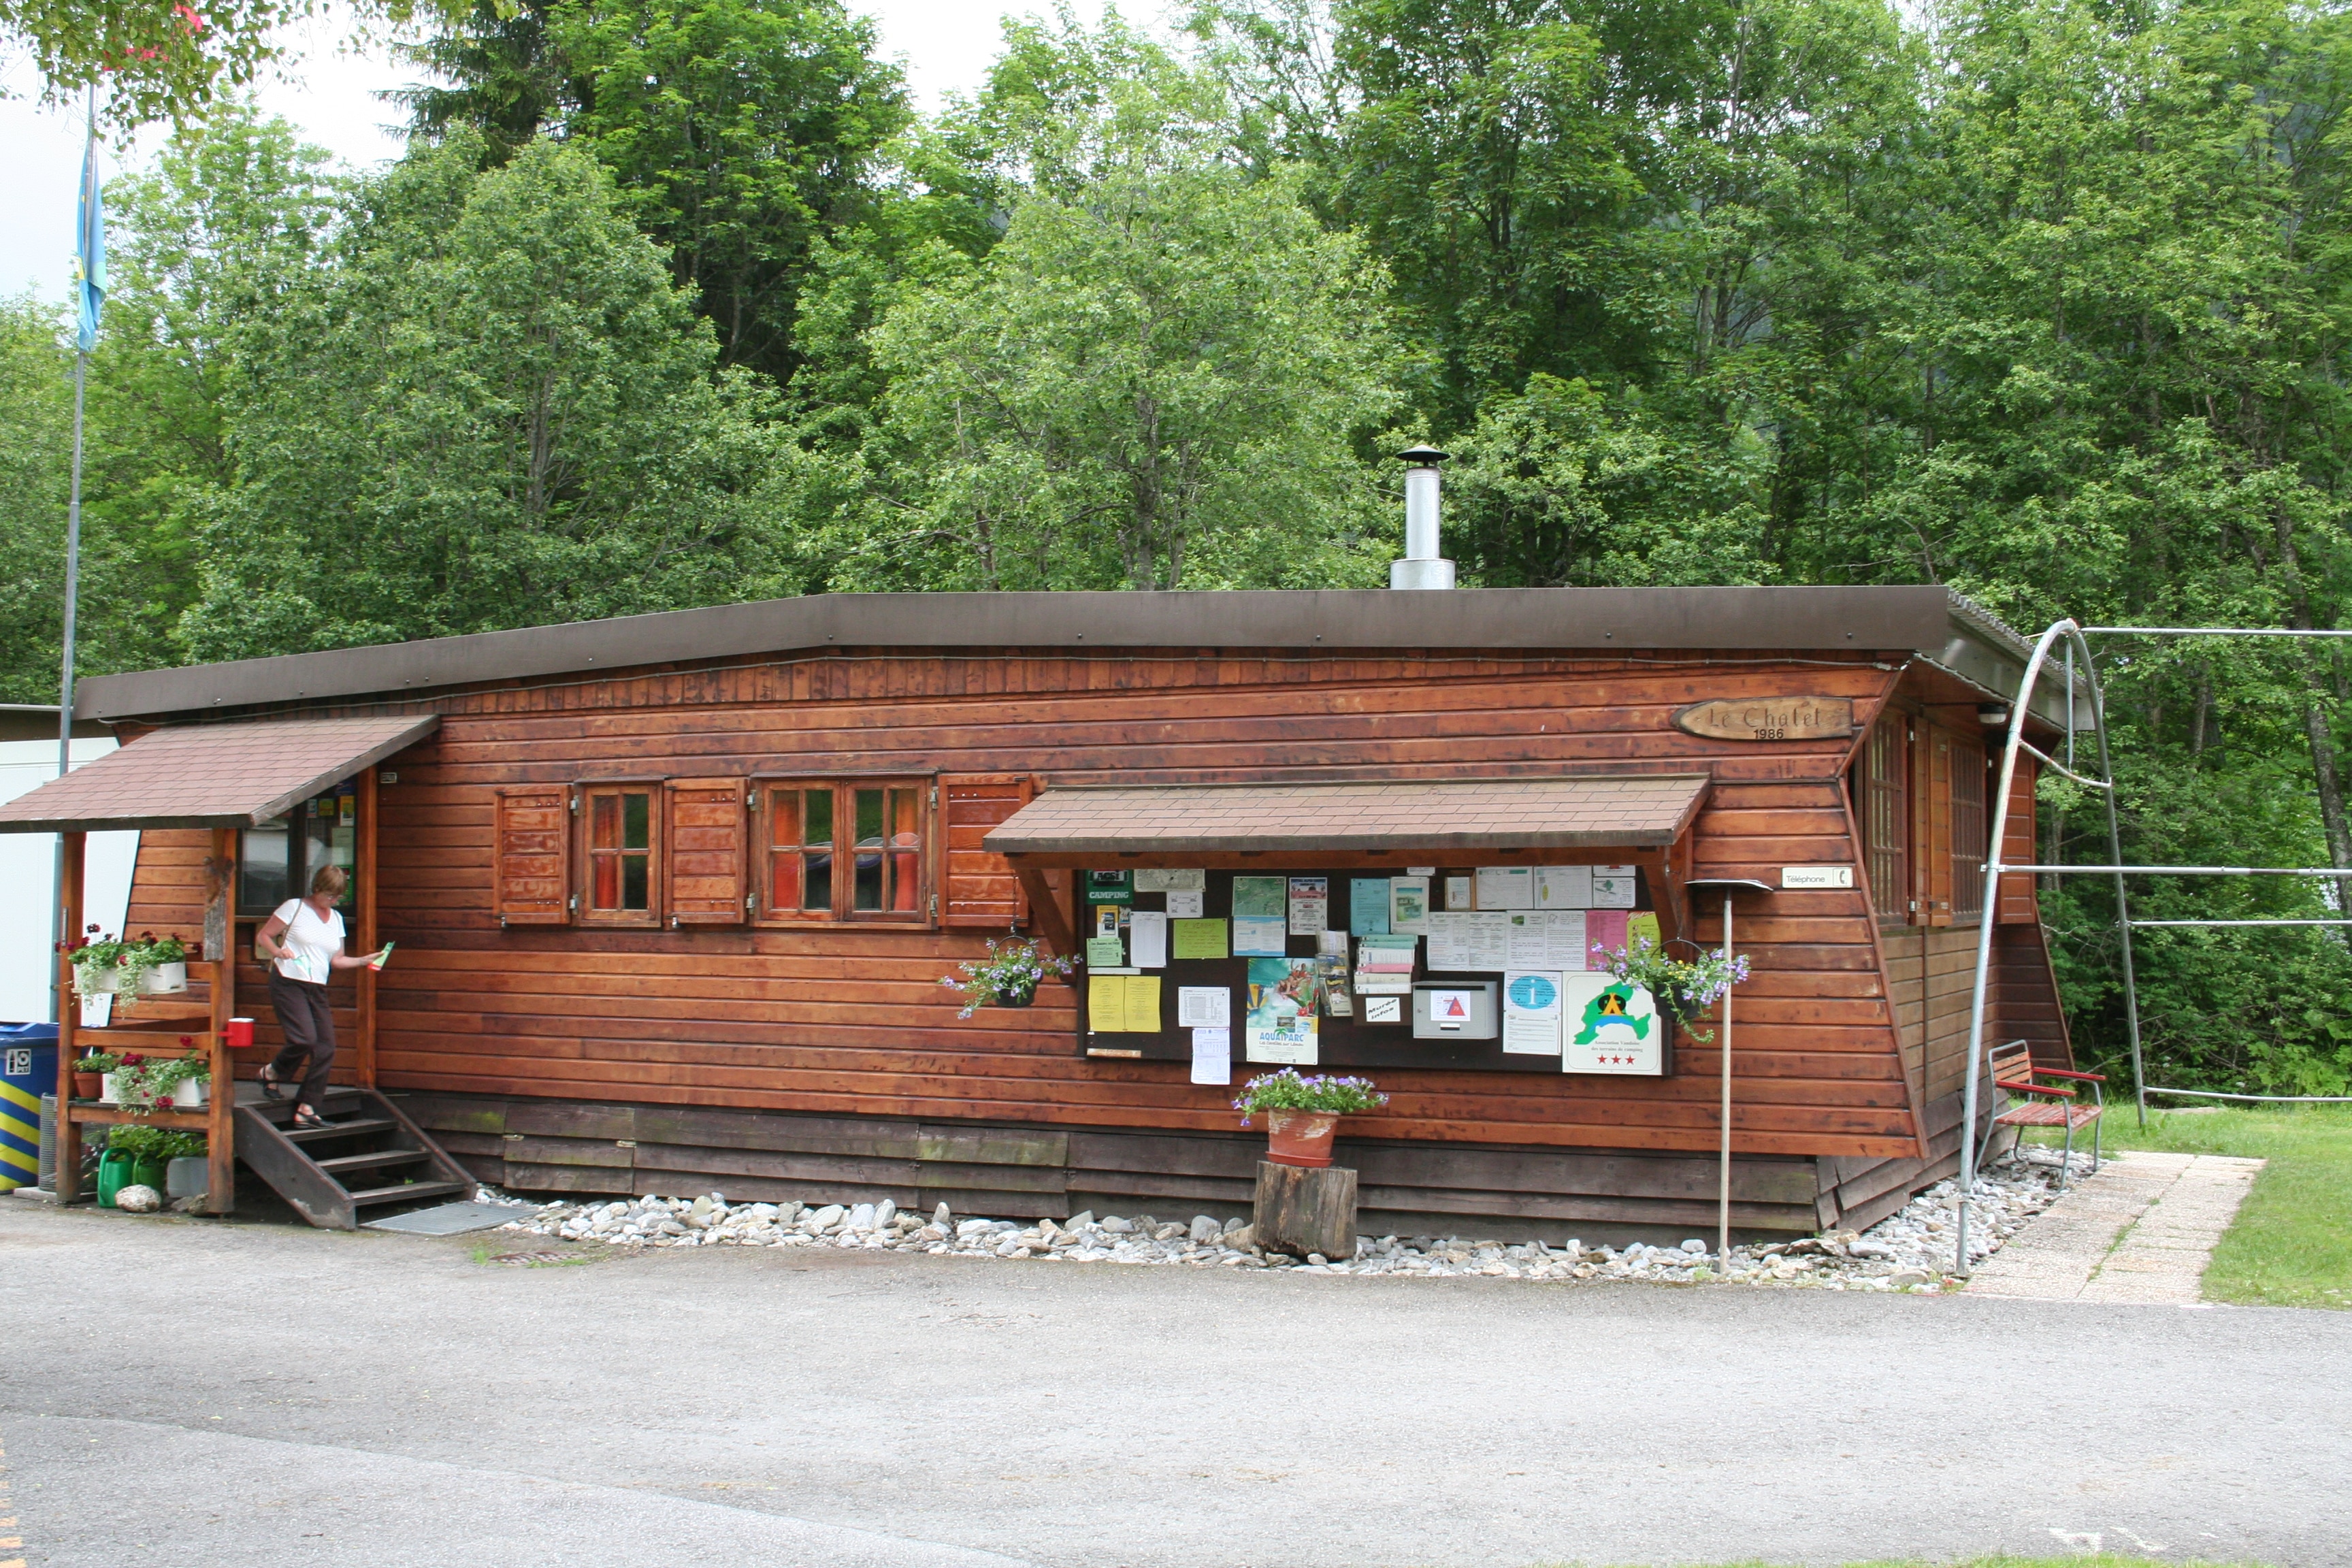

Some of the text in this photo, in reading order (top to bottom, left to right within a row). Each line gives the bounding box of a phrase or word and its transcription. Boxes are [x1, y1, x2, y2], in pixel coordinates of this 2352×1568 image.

[1709, 708, 1731, 728] Le
[1753, 729, 1784, 739] 1986
[1786, 875, 1825, 884] Téléphone
